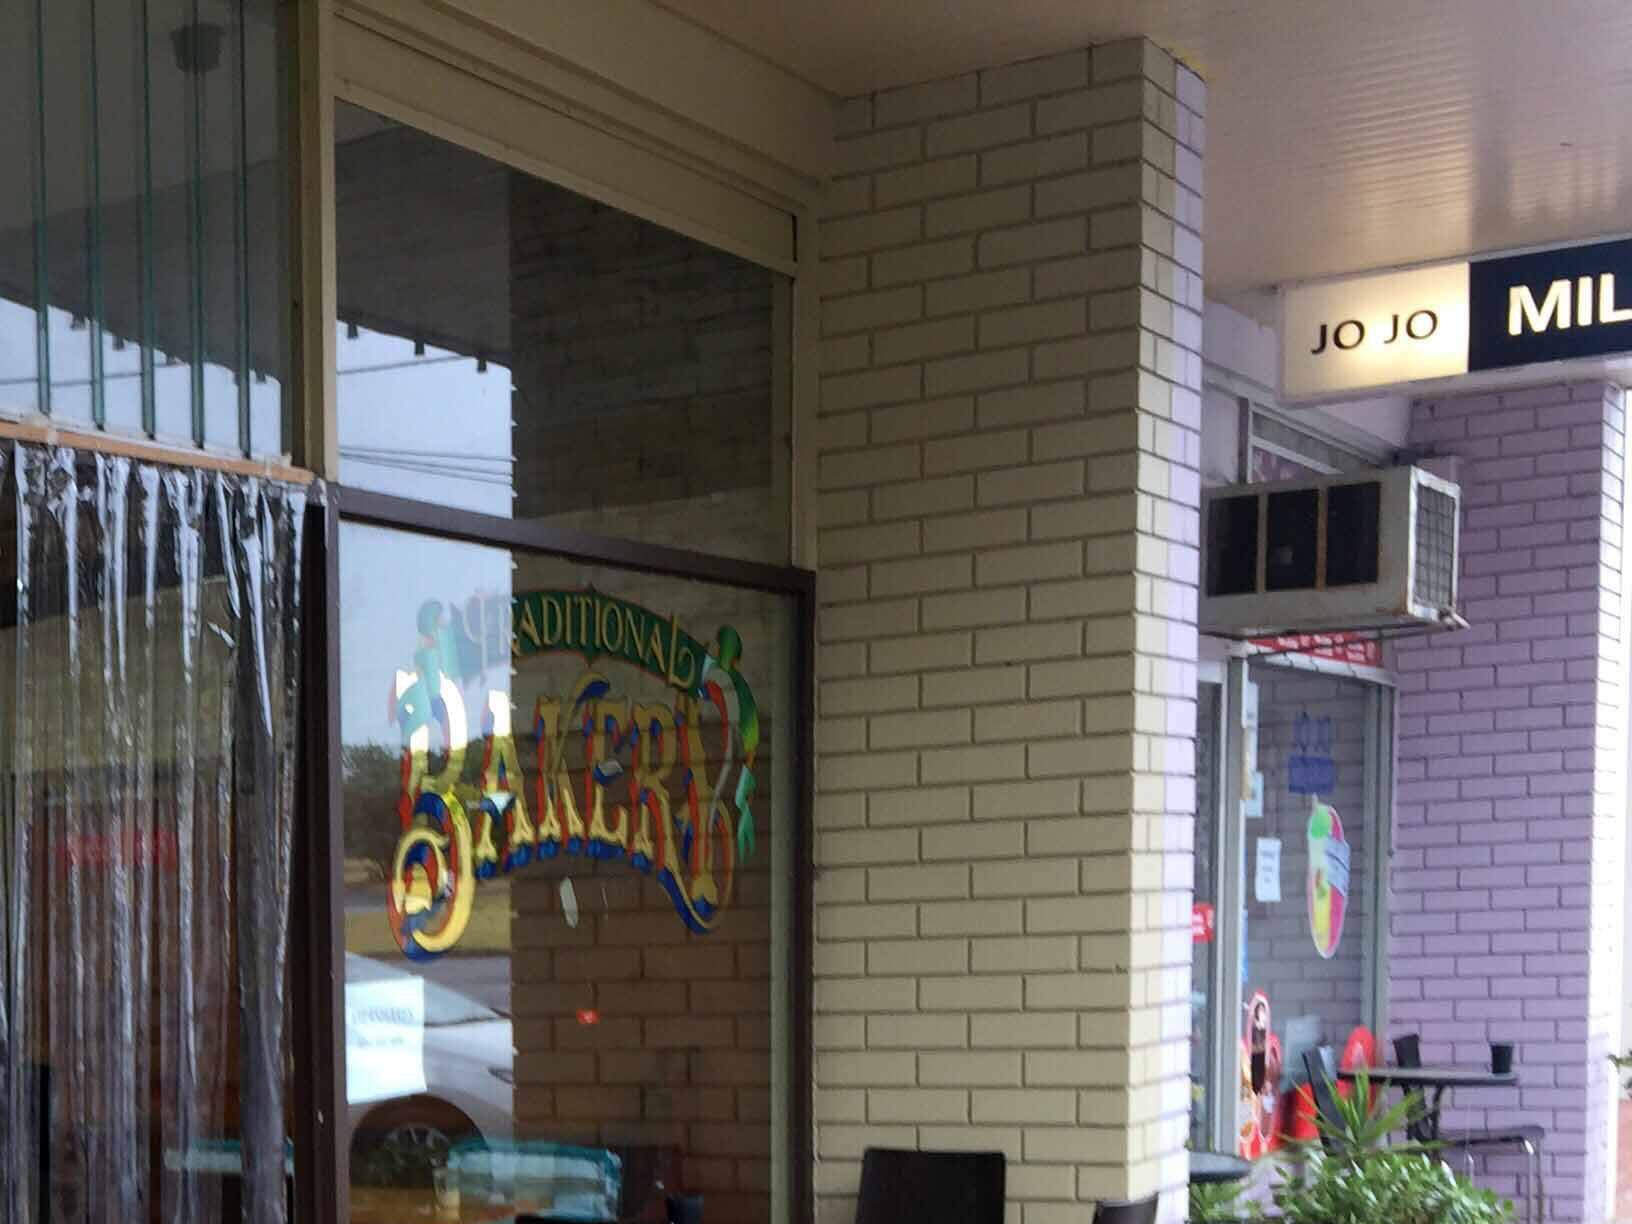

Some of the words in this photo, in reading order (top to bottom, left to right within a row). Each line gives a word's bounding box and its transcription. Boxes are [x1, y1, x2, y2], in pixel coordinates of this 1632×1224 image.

[1310, 319, 1366, 355] JO
[1383, 309, 1438, 344] JO
[1508, 272, 1632, 337] MIL
[463, 595, 696, 689] TRADITIONAL
[388, 667, 740, 963] BAKERY
